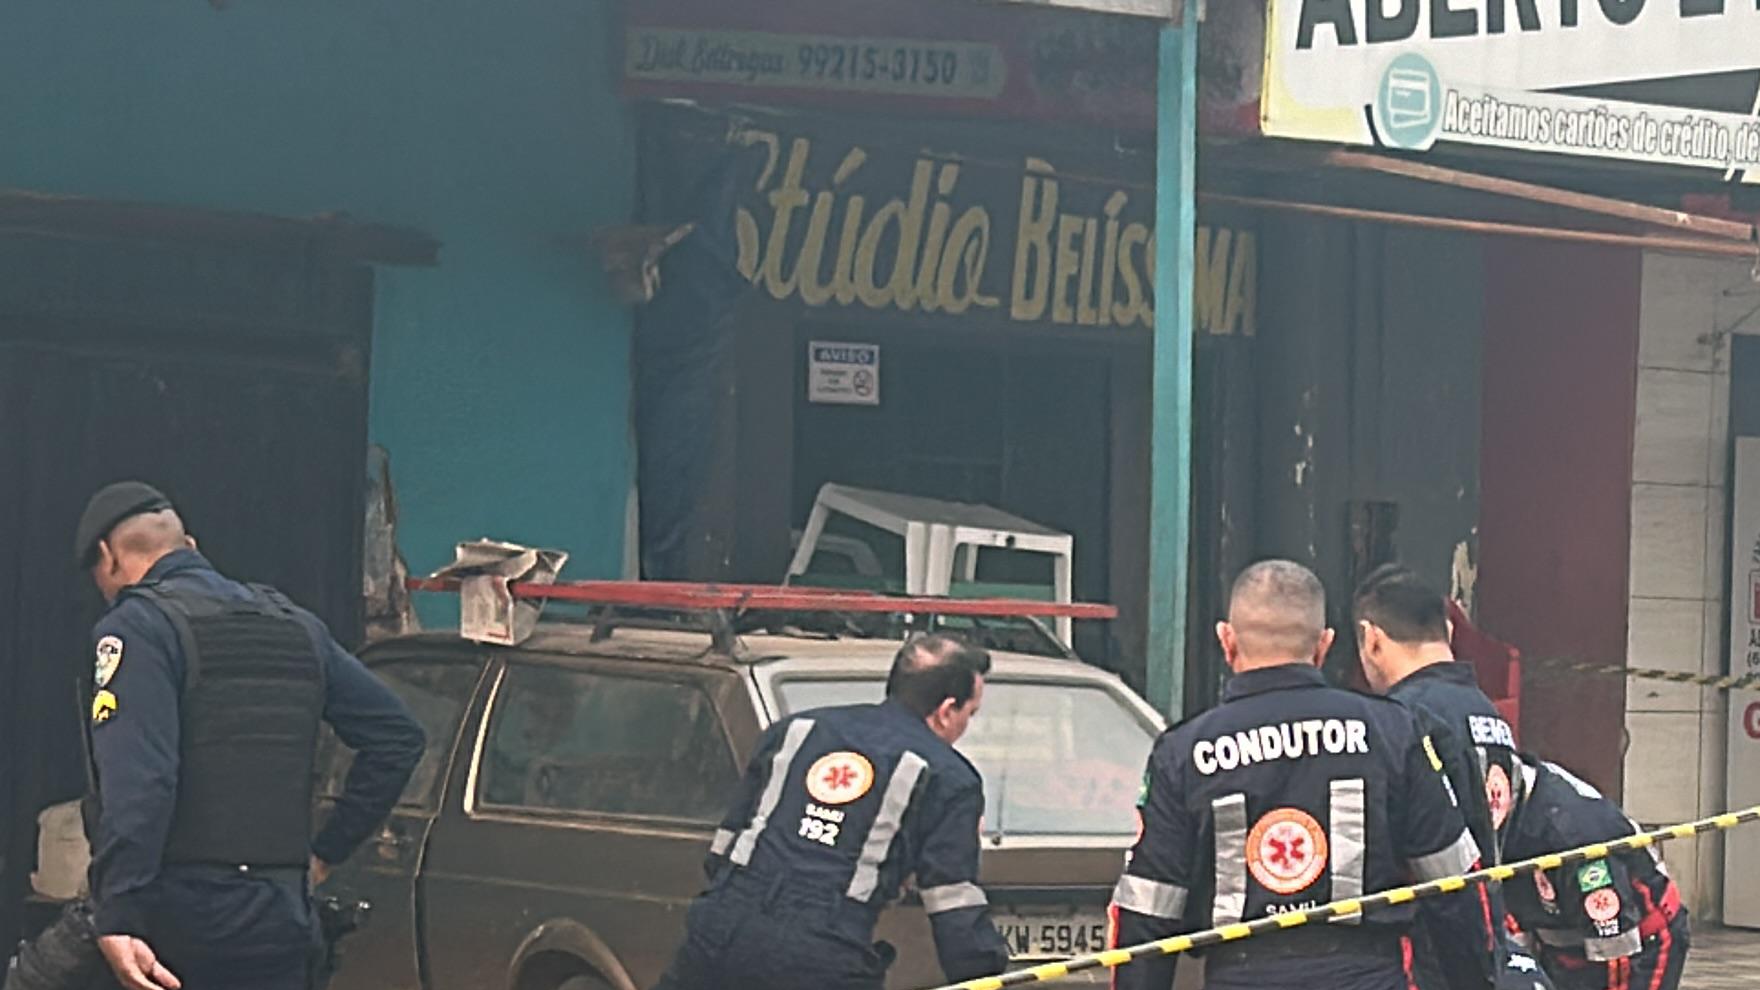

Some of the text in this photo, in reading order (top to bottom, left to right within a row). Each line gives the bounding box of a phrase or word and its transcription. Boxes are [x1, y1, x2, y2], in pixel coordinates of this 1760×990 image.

[1443, 89, 1550, 143] Aceitamos
[1553, 105, 1628, 149] cartões
[1632, 112, 1658, 156] de
[1660, 115, 1731, 164] crédito,
[1193, 719, 1369, 774] CONDUTOR
[799, 818, 840, 847] 192
[998, 925, 1030, 956] KW
